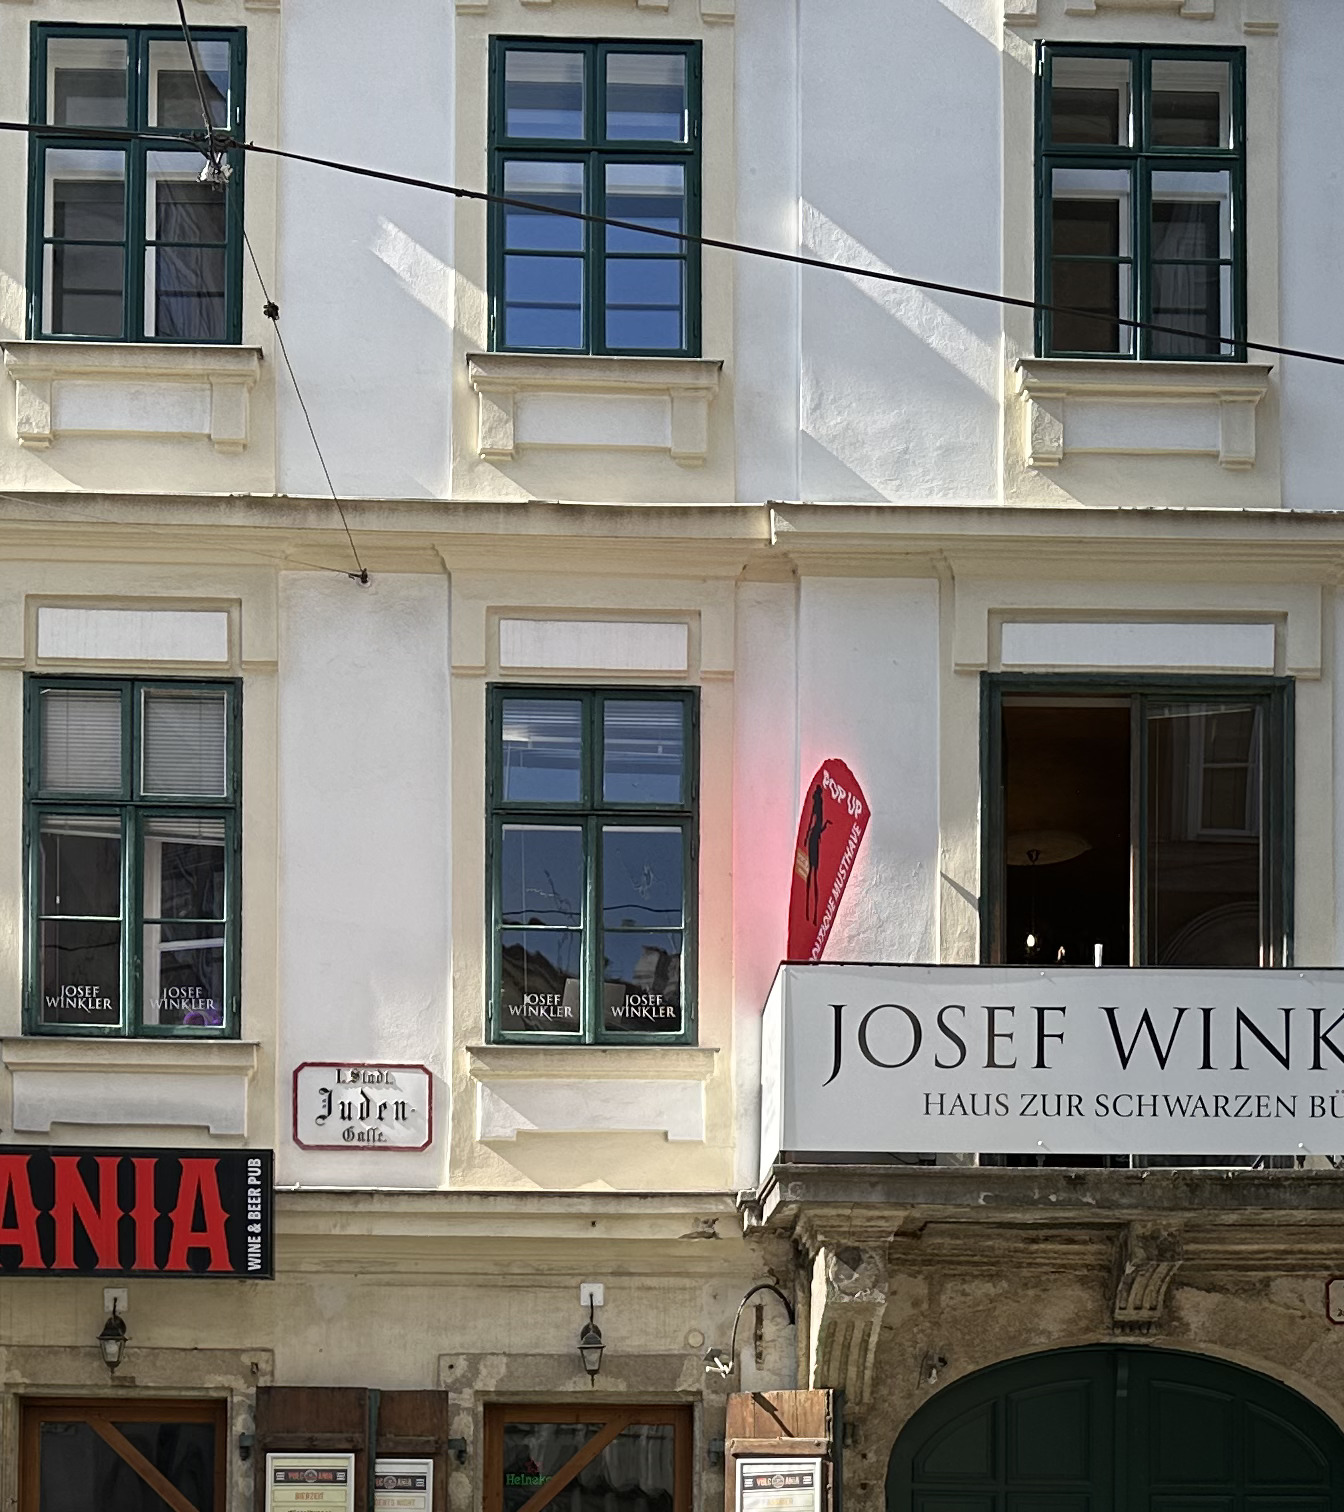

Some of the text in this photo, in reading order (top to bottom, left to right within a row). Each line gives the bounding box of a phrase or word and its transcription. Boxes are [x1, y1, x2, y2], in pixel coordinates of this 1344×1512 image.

[822, 769, 863, 818] POP UP
[809, 898, 837, 964] OUTIQUE
[60, 985, 100, 998] JOSEF
[163, 987, 203, 999] JOSEF
[46, 996, 113, 1013] WINKLER
[150, 998, 216, 1013] WINKLER
[523, 994, 561, 1006] JOSEF
[625, 995, 664, 1007] JOSEF
[509, 1005, 574, 1021] WINKLER
[611, 1006, 677, 1022] WINKLER
[822, 1002, 1067, 1087] JOSEF
[922, 1093, 1010, 1118] HAUS
[1019, 1094, 1084, 1118] ZUR
[1095, 1094, 1298, 1119] SCHWARZEN
[247, 1158, 262, 1271] WINE & BEER PUB
